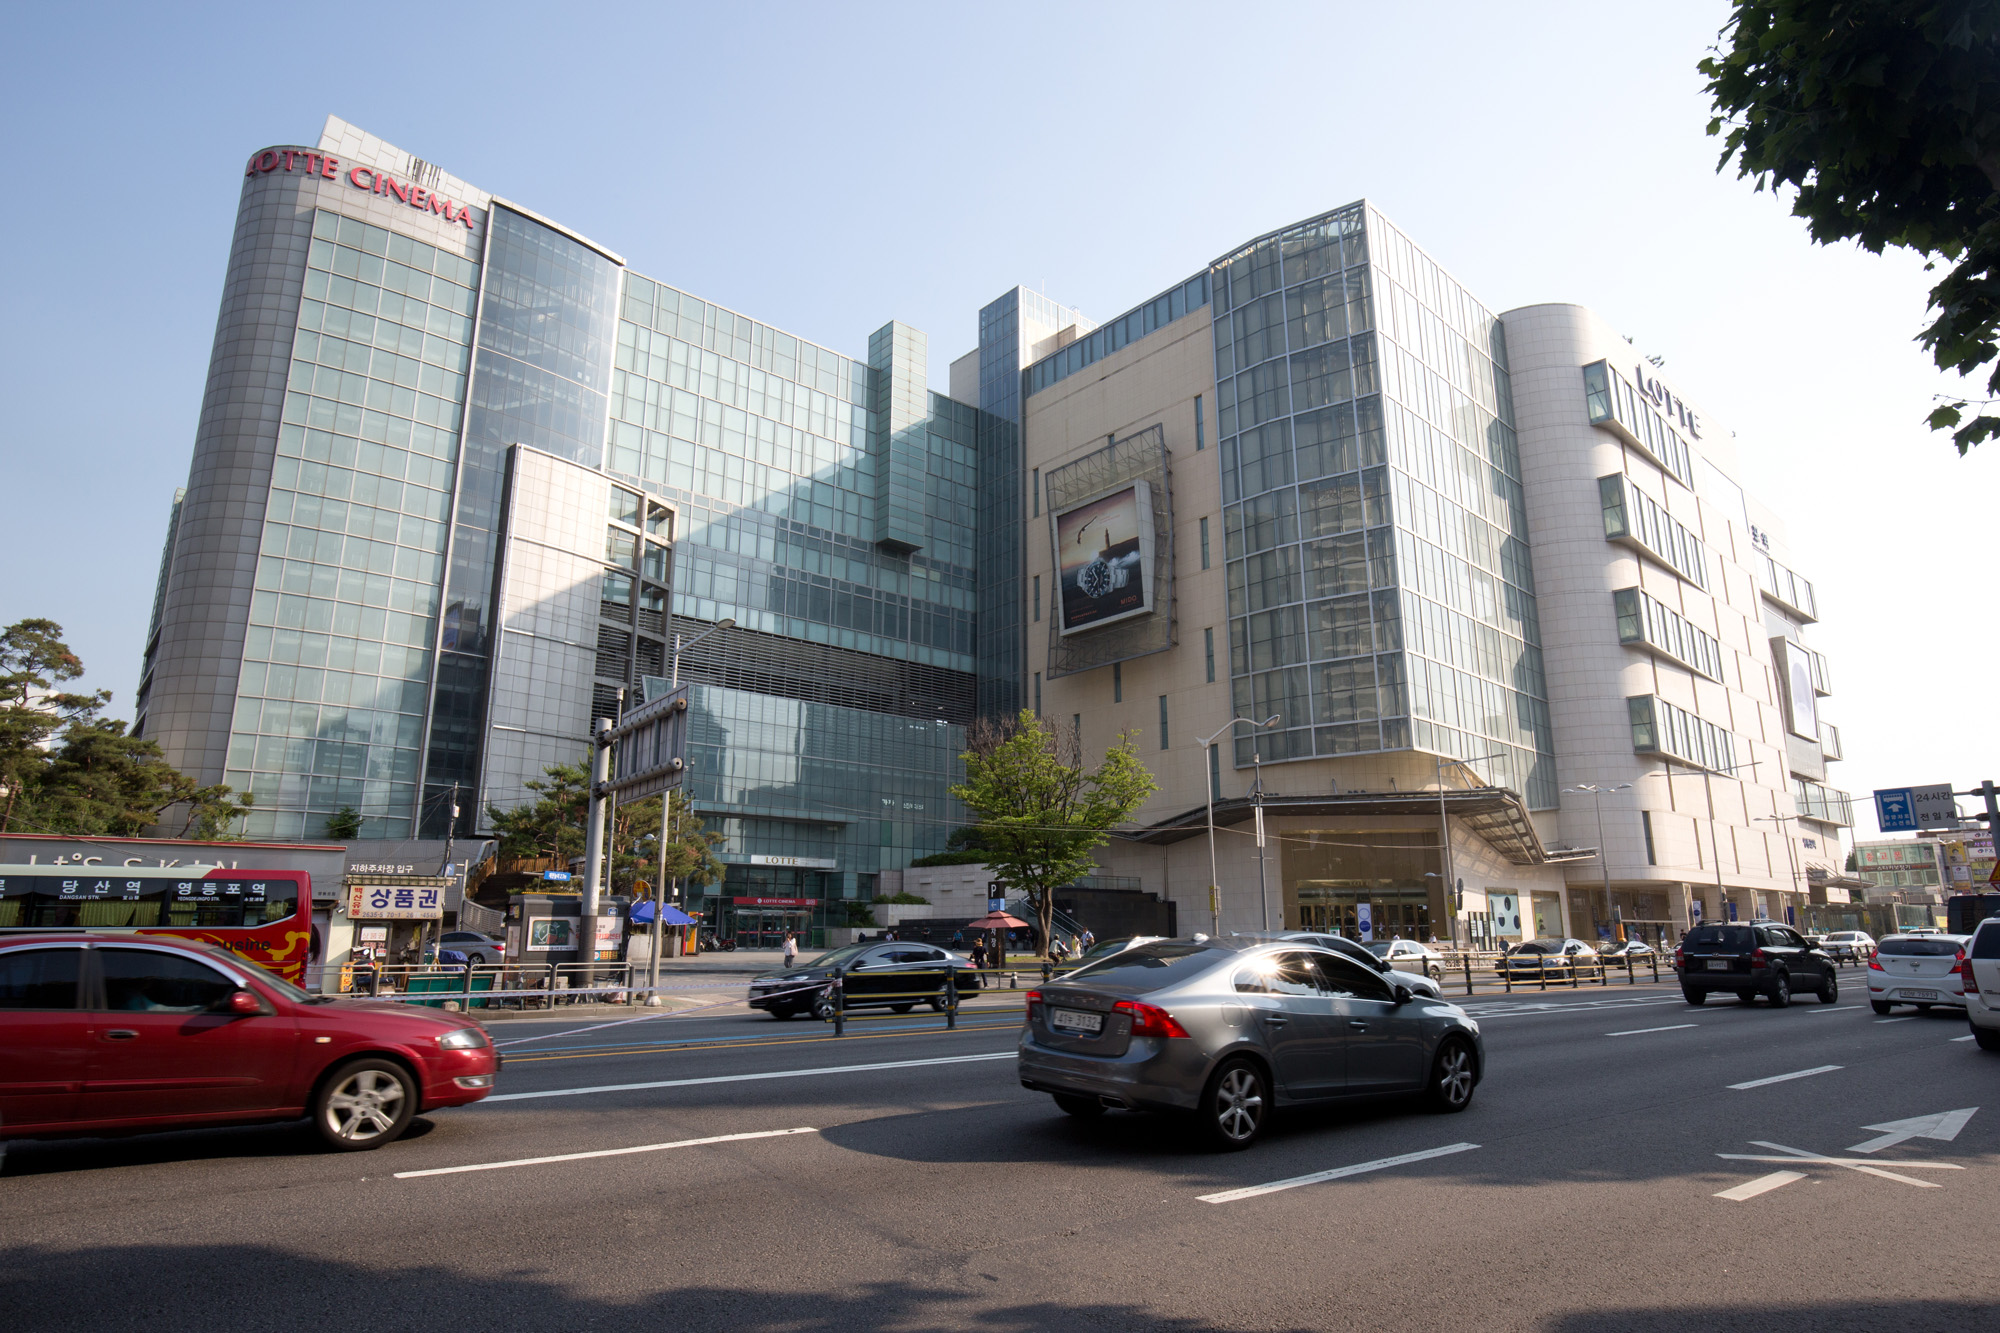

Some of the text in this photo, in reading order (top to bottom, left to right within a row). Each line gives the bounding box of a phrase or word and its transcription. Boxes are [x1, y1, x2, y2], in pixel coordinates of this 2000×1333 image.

[350, 166, 474, 229] CINEMA
[1635, 364, 1702, 441] LOTTE
[1120, 594, 1137, 605] MIDO
[1916, 791, 1951, 802] 24시간
[1920, 810, 1955, 821] 전일제
[765, 856, 799, 865] LOTTE
[350, 863, 414, 874] 지하주차장 입구
[990, 884, 997, 898] P
[370, 888, 438, 909] 상품권
